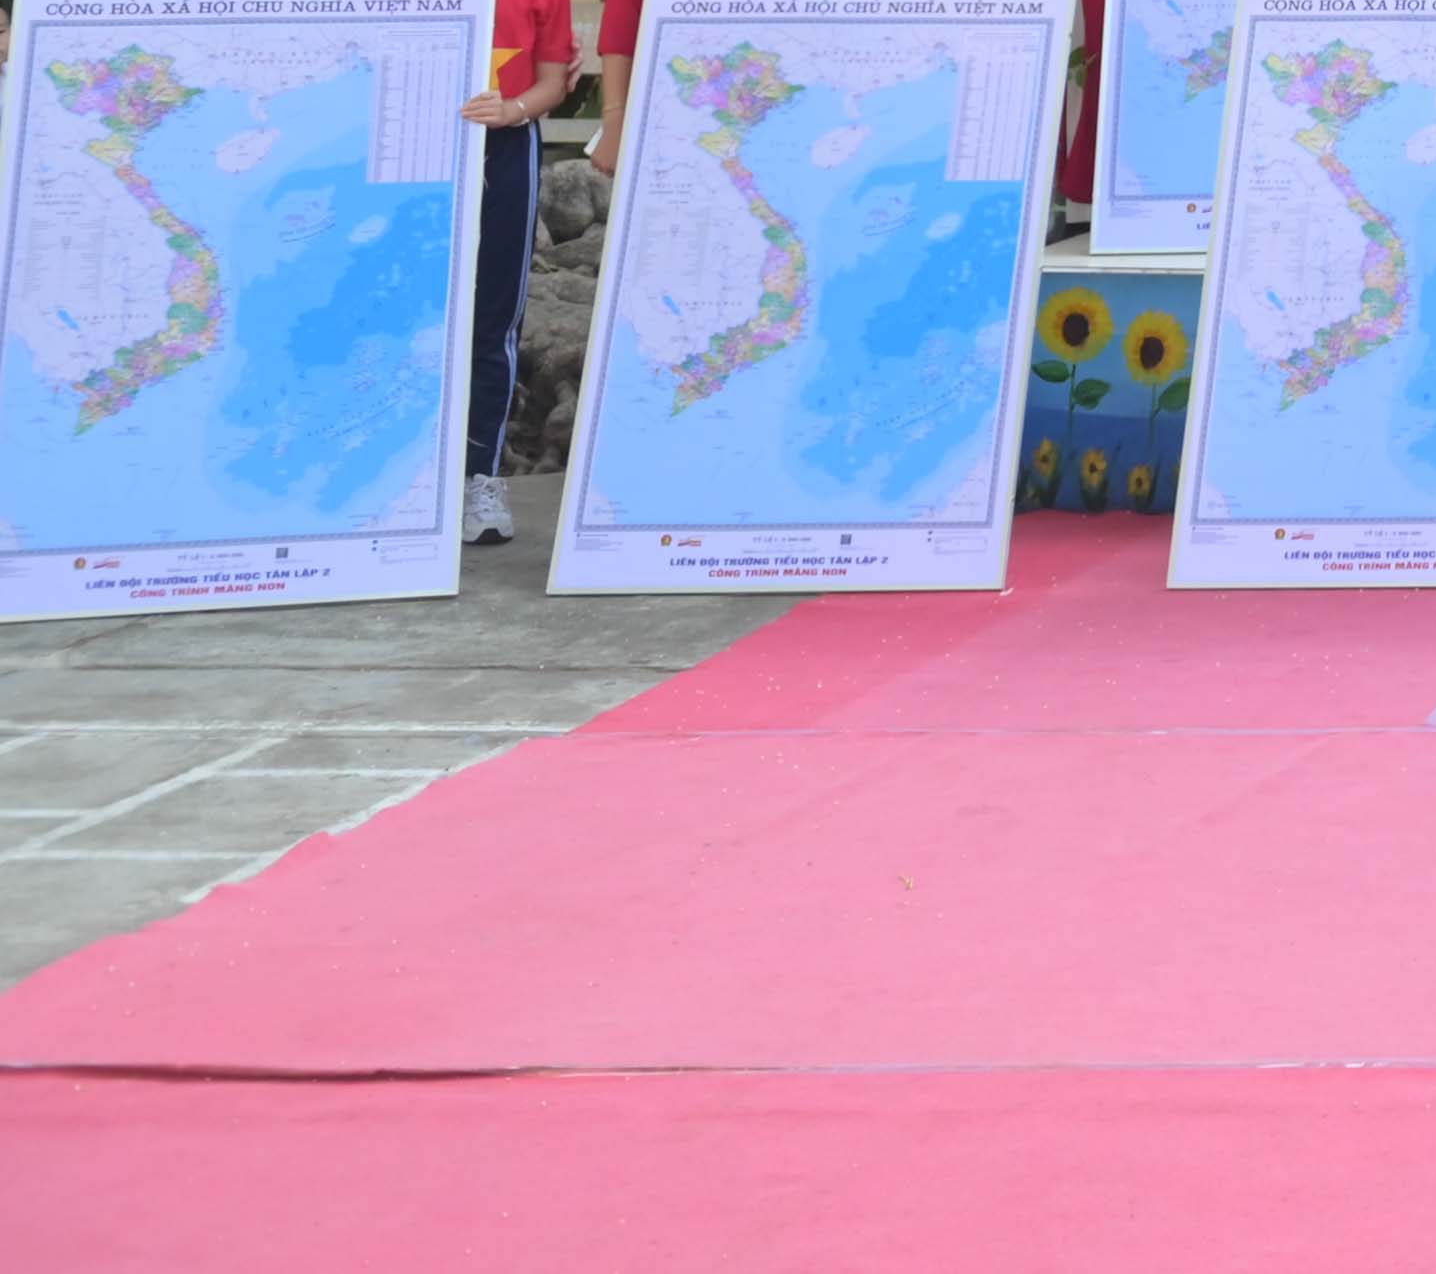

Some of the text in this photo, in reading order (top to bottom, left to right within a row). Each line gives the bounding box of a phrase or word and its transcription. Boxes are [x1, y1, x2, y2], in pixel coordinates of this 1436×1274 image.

[46, 0, 104, 18] CỘNG
[111, 0, 154, 15] HÒA
[161, 0, 190, 14] XÃ
[417, 0, 464, 12] NAM
